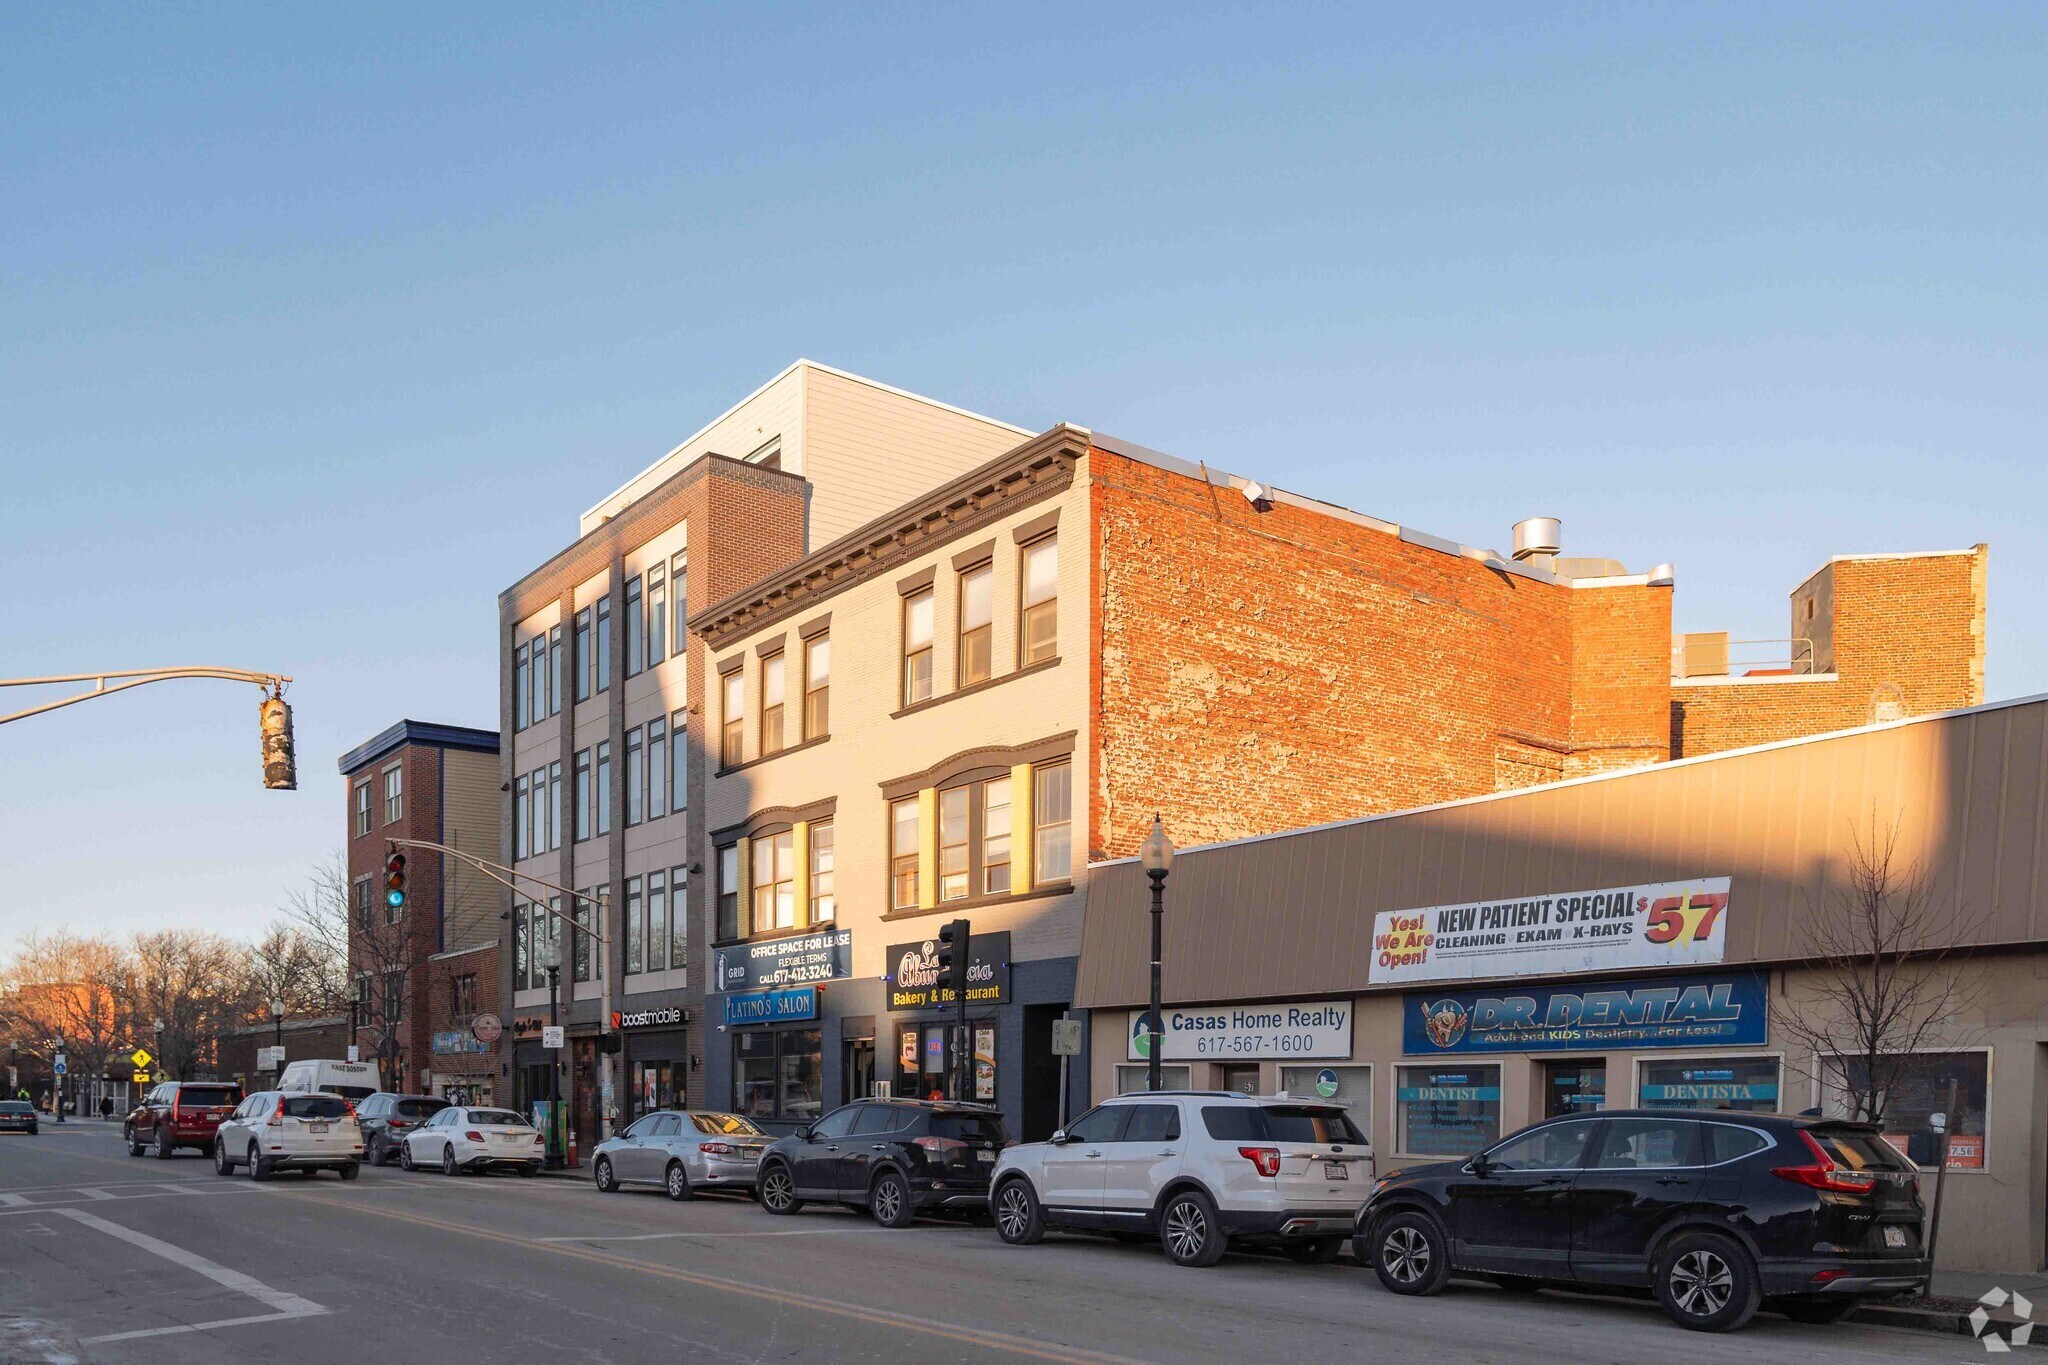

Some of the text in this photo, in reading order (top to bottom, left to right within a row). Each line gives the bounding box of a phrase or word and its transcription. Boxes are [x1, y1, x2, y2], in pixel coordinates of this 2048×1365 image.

[1437, 908, 1476, 934] NEW
[1479, 900, 1552, 930] PATIENT
[1556, 892, 1635, 923] SPECIAL
[1390, 914, 1424, 932] Yes!
[1376, 932, 1434, 950] We Are
[1436, 932, 1506, 950] CLEANING
[1516, 928, 1562, 943] EXAM
[1573, 922, 1634, 939] X-RAYS
[751, 934, 850, 958] OFFICE SPACE FOR LEASE
[778, 953, 827, 967] FLEXIBLE TERMS
[920, 941, 940, 970] La
[1378, 949, 1428, 970] Open!
[728, 966, 744, 978] GRID
[760, 963, 832, 984] CALL 617-412-3240
[898, 951, 993, 987] Abuncia
[894, 985, 1000, 1006] Bakery & Reaurant
[778, 996, 810, 1014] SALON
[1172, 1007, 1346, 1030] Casas Home Realty
[1484, 1032, 1517, 1042] Adult
[1521, 1031, 1544, 1041] and
[1550, 1030, 1580, 1040] KIDS
[1686, 1024, 1722, 1034] Less!
[1198, 1034, 1312, 1052] 617-567-1600
[346, 1065, 368, 1073] BOSTON
[1420, 1088, 1478, 1100] DENTIST
[1664, 1084, 1752, 1099] DENTISTA
[1952, 1146, 1974, 1156] 7.56
